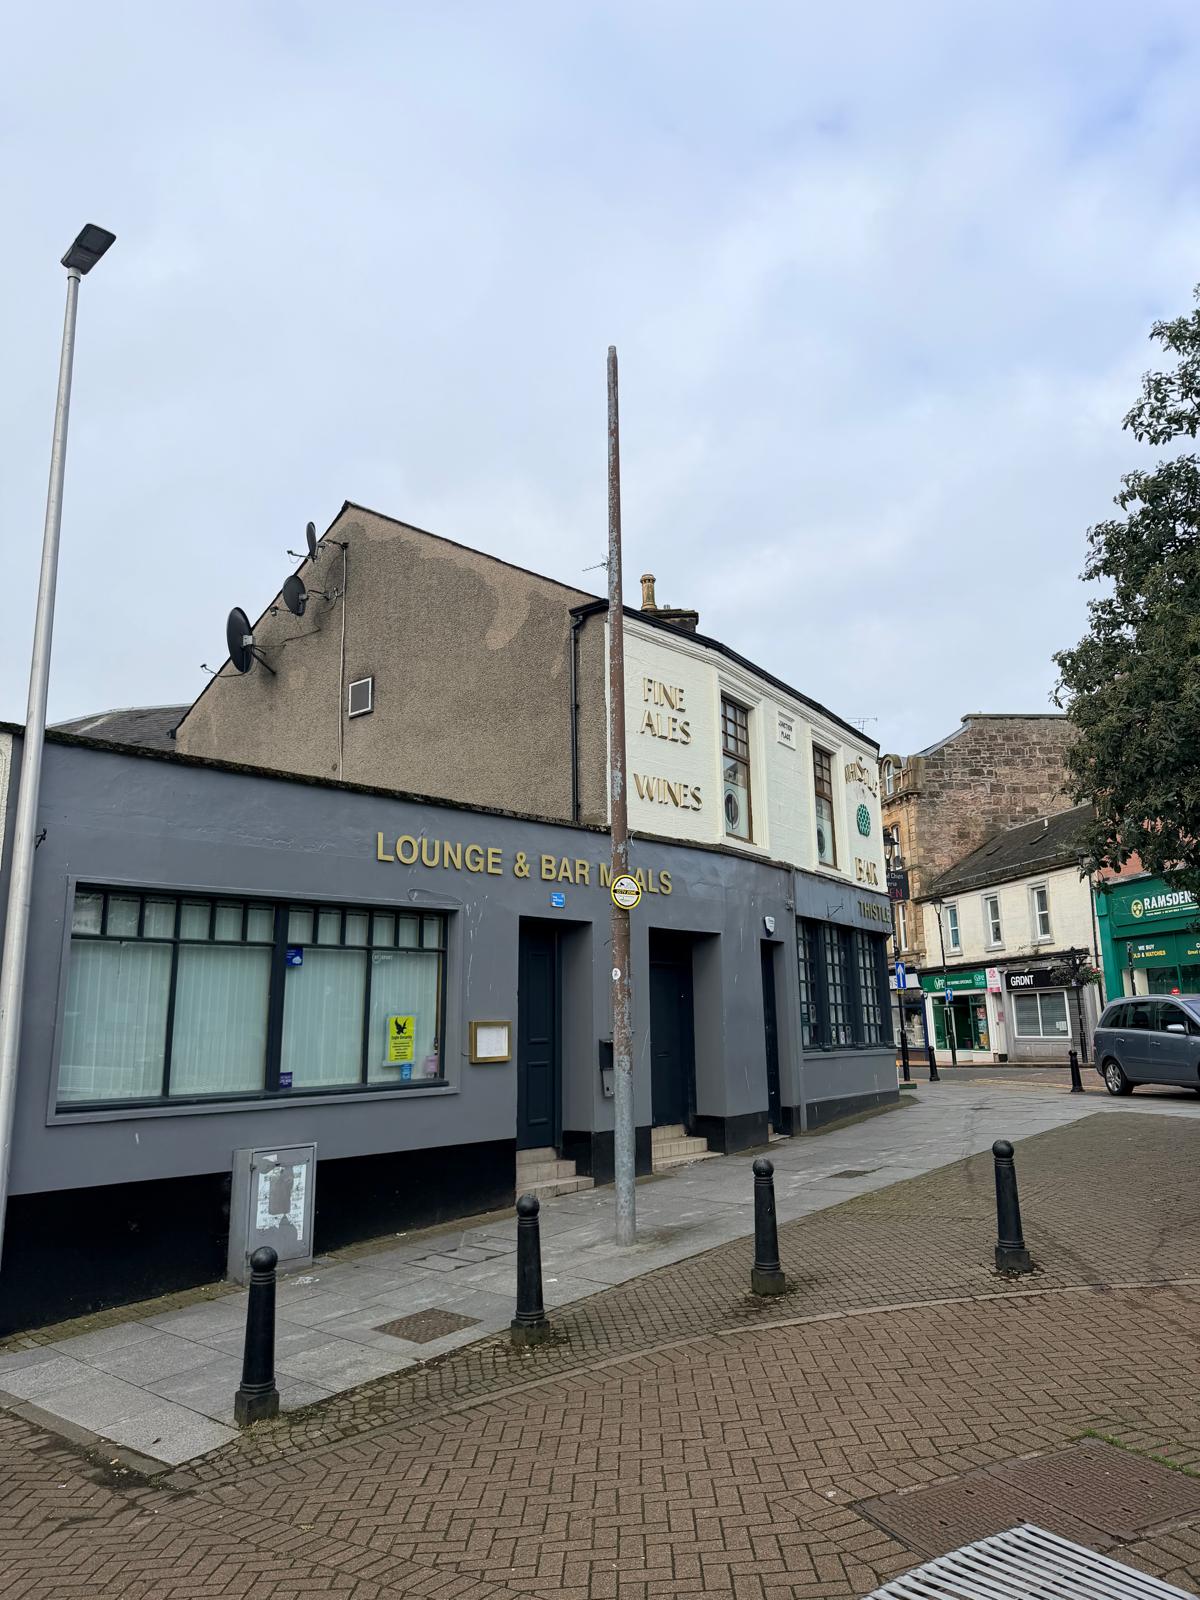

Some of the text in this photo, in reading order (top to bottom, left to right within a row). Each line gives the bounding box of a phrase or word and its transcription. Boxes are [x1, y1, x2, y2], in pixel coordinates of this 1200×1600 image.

[643, 677, 686, 713] FINE
[640, 709, 692, 745] ALES
[633, 772, 704, 812] WINES
[376, 831, 673, 896] LOUNGE & BAR MALS
[855, 857, 879, 886] BAR
[858, 900, 891, 924] THISTLE
[1144, 891, 1196, 910] RAMSDEN
[1010, 975, 1034, 986] GRDNT
